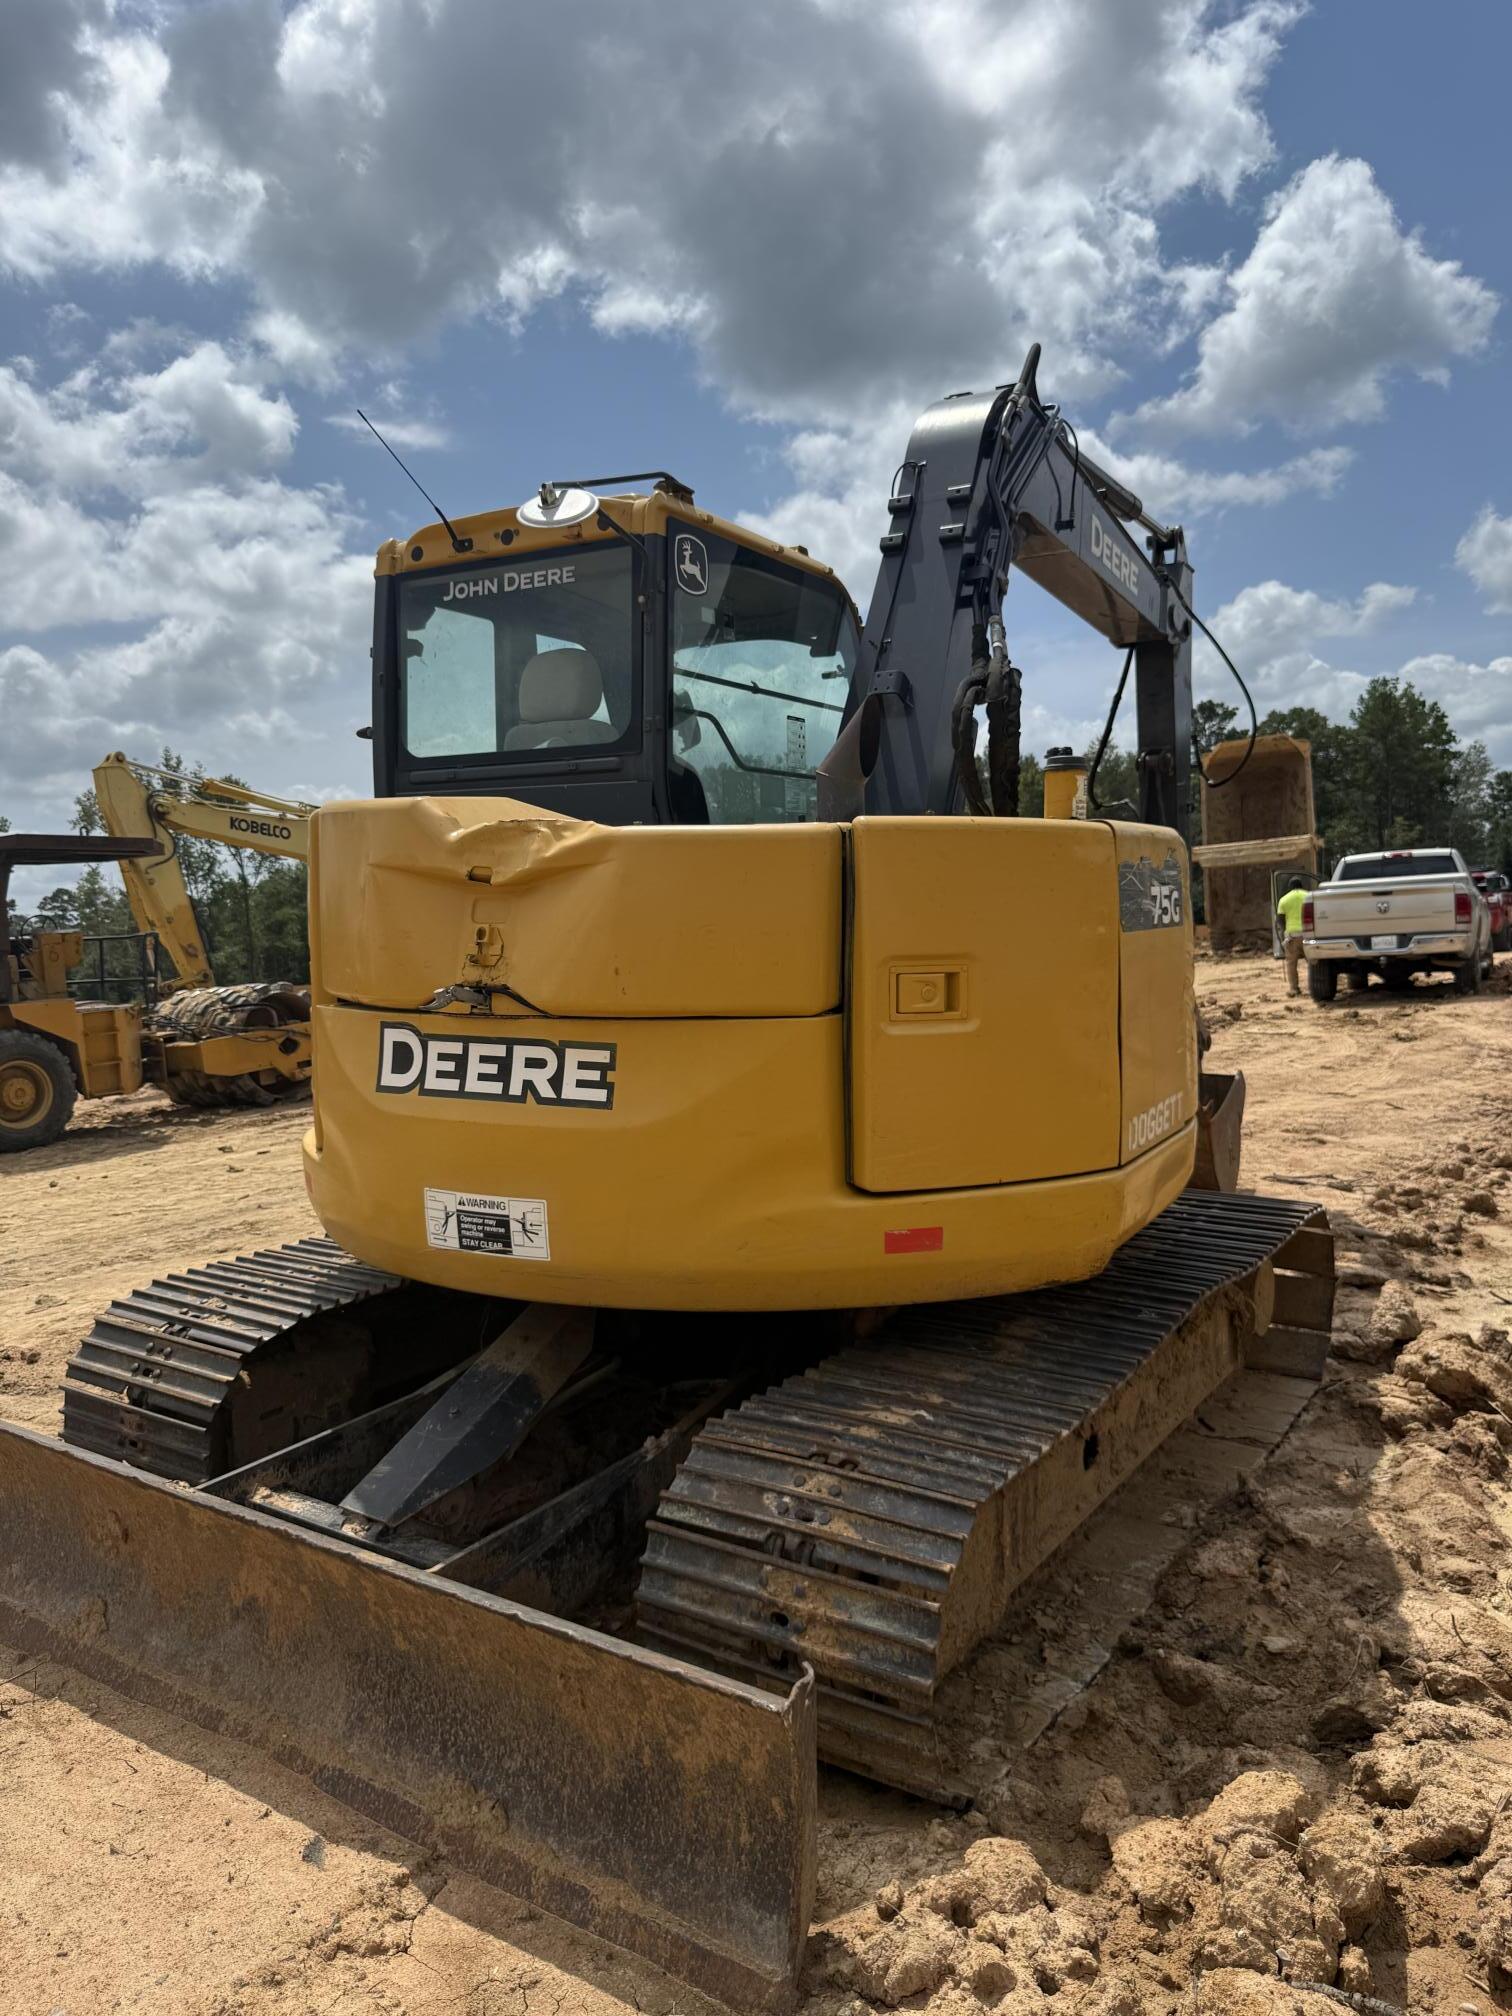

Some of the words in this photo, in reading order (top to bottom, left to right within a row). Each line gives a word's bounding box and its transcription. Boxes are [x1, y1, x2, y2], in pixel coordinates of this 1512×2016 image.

[1091, 513, 1139, 596] DEERE
[443, 578, 498, 601] JOHN
[503, 566, 576, 592] DEERE
[229, 816, 292, 840] KOBELCO
[380, 1028, 612, 1102] DEERE
[466, 1198, 506, 1211] WARNING
[462, 1239, 479, 1247] STAY
[480, 1240, 503, 1249] CLEAR
